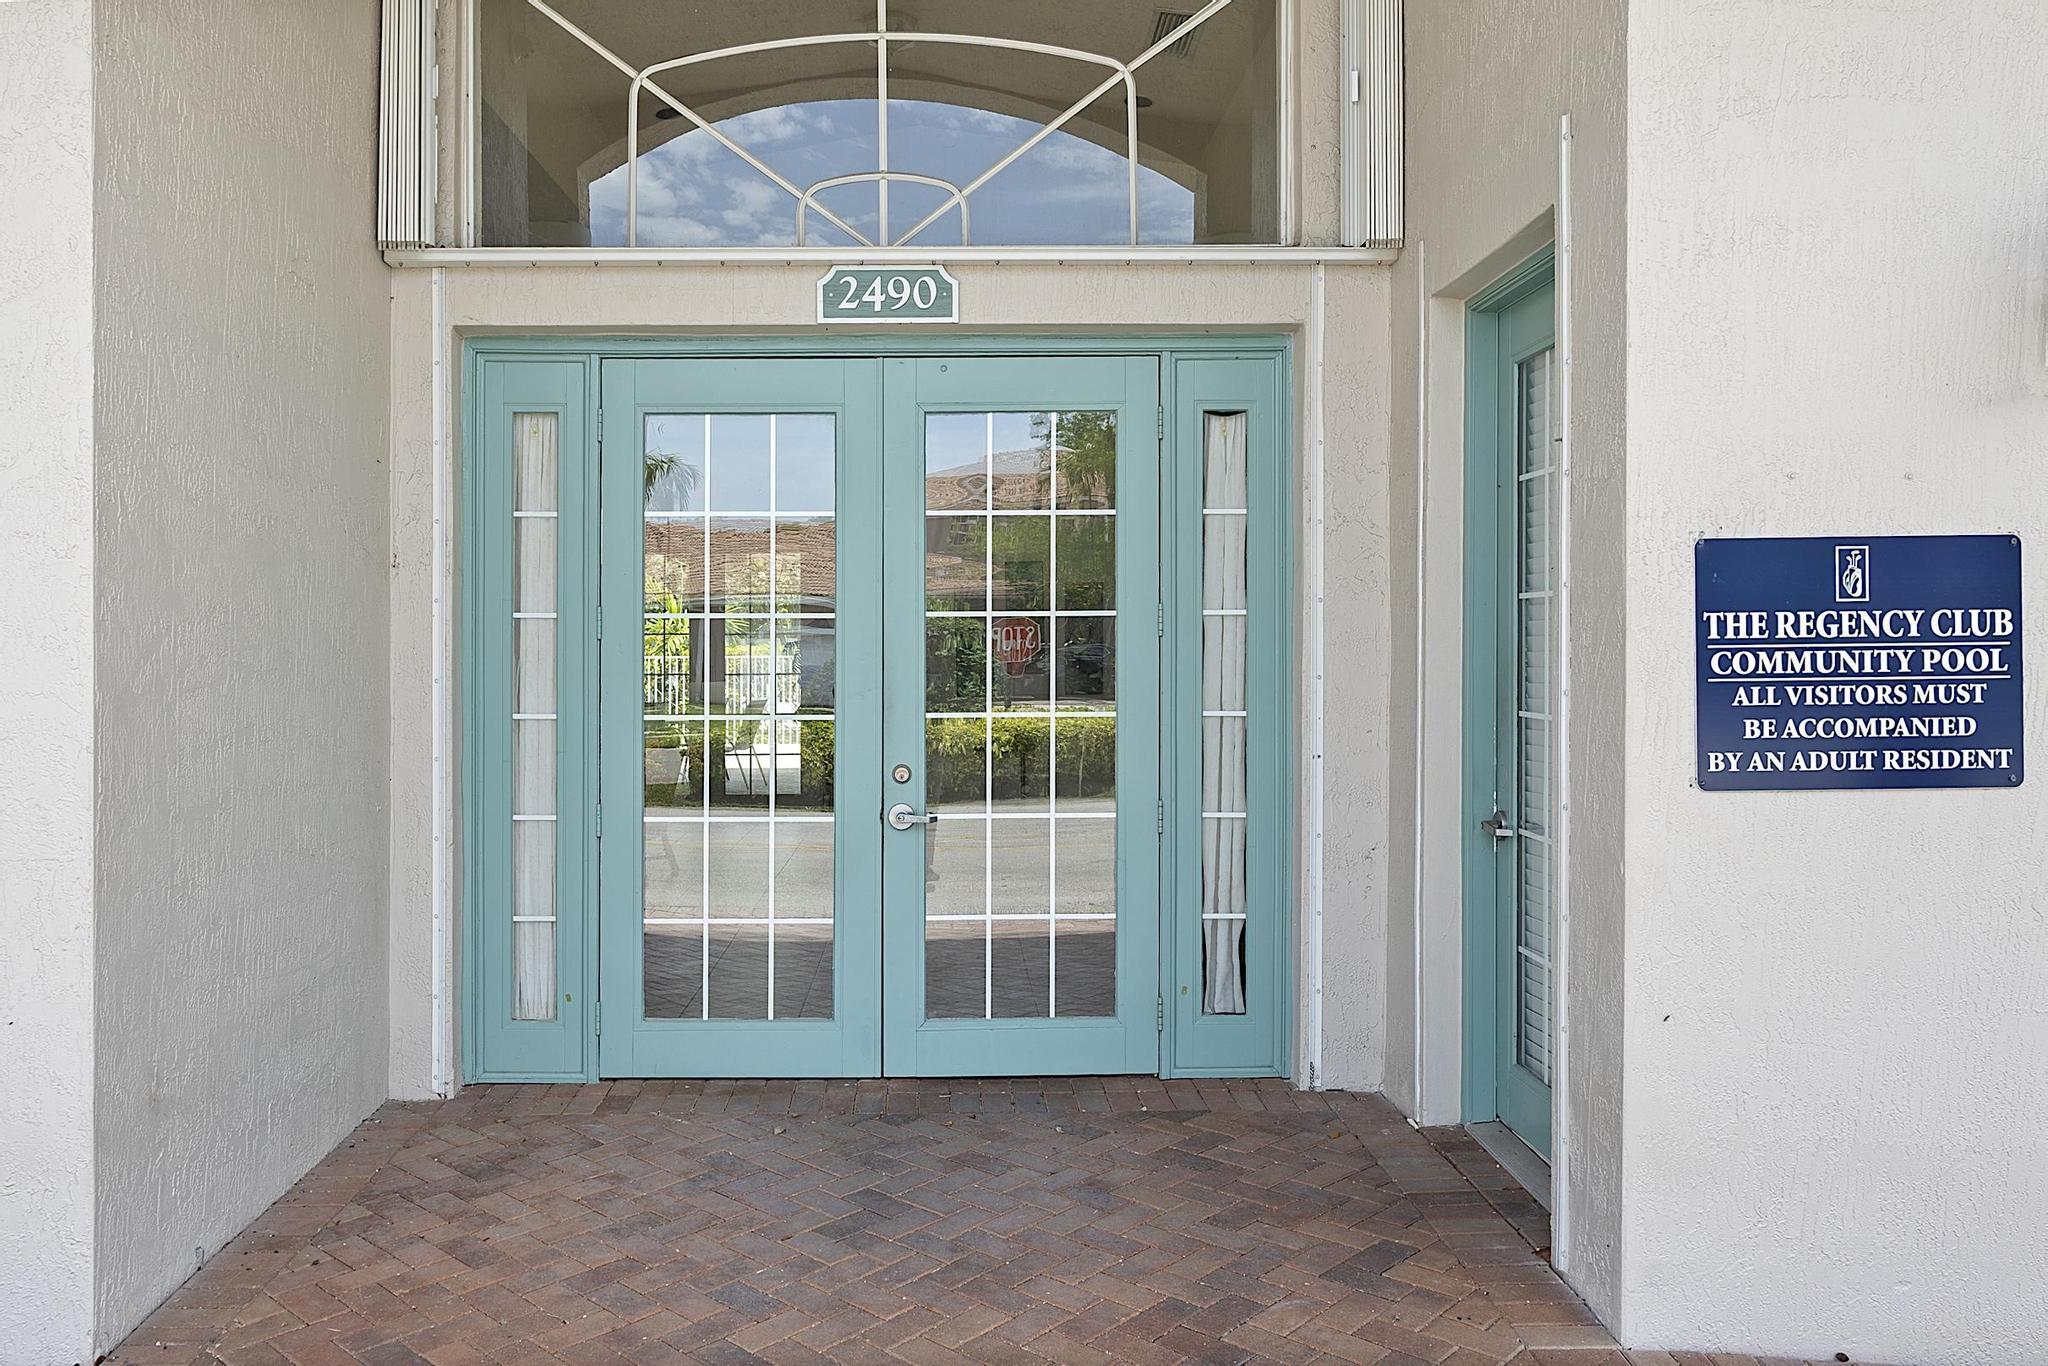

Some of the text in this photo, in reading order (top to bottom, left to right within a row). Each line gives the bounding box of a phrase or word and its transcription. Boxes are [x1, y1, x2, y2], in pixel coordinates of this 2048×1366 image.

[838, 276, 937, 312] 2490
[1703, 608, 2014, 640] THE REGENCY CLUB
[1710, 648, 2009, 675] COMMUNITY POOL
[1731, 683, 1987, 706] ALL VISITORS MUST
[1743, 716, 1977, 739] BE ACCOMPANIED
[1707, 748, 2013, 772] BY AN ADULT RESIDENT
